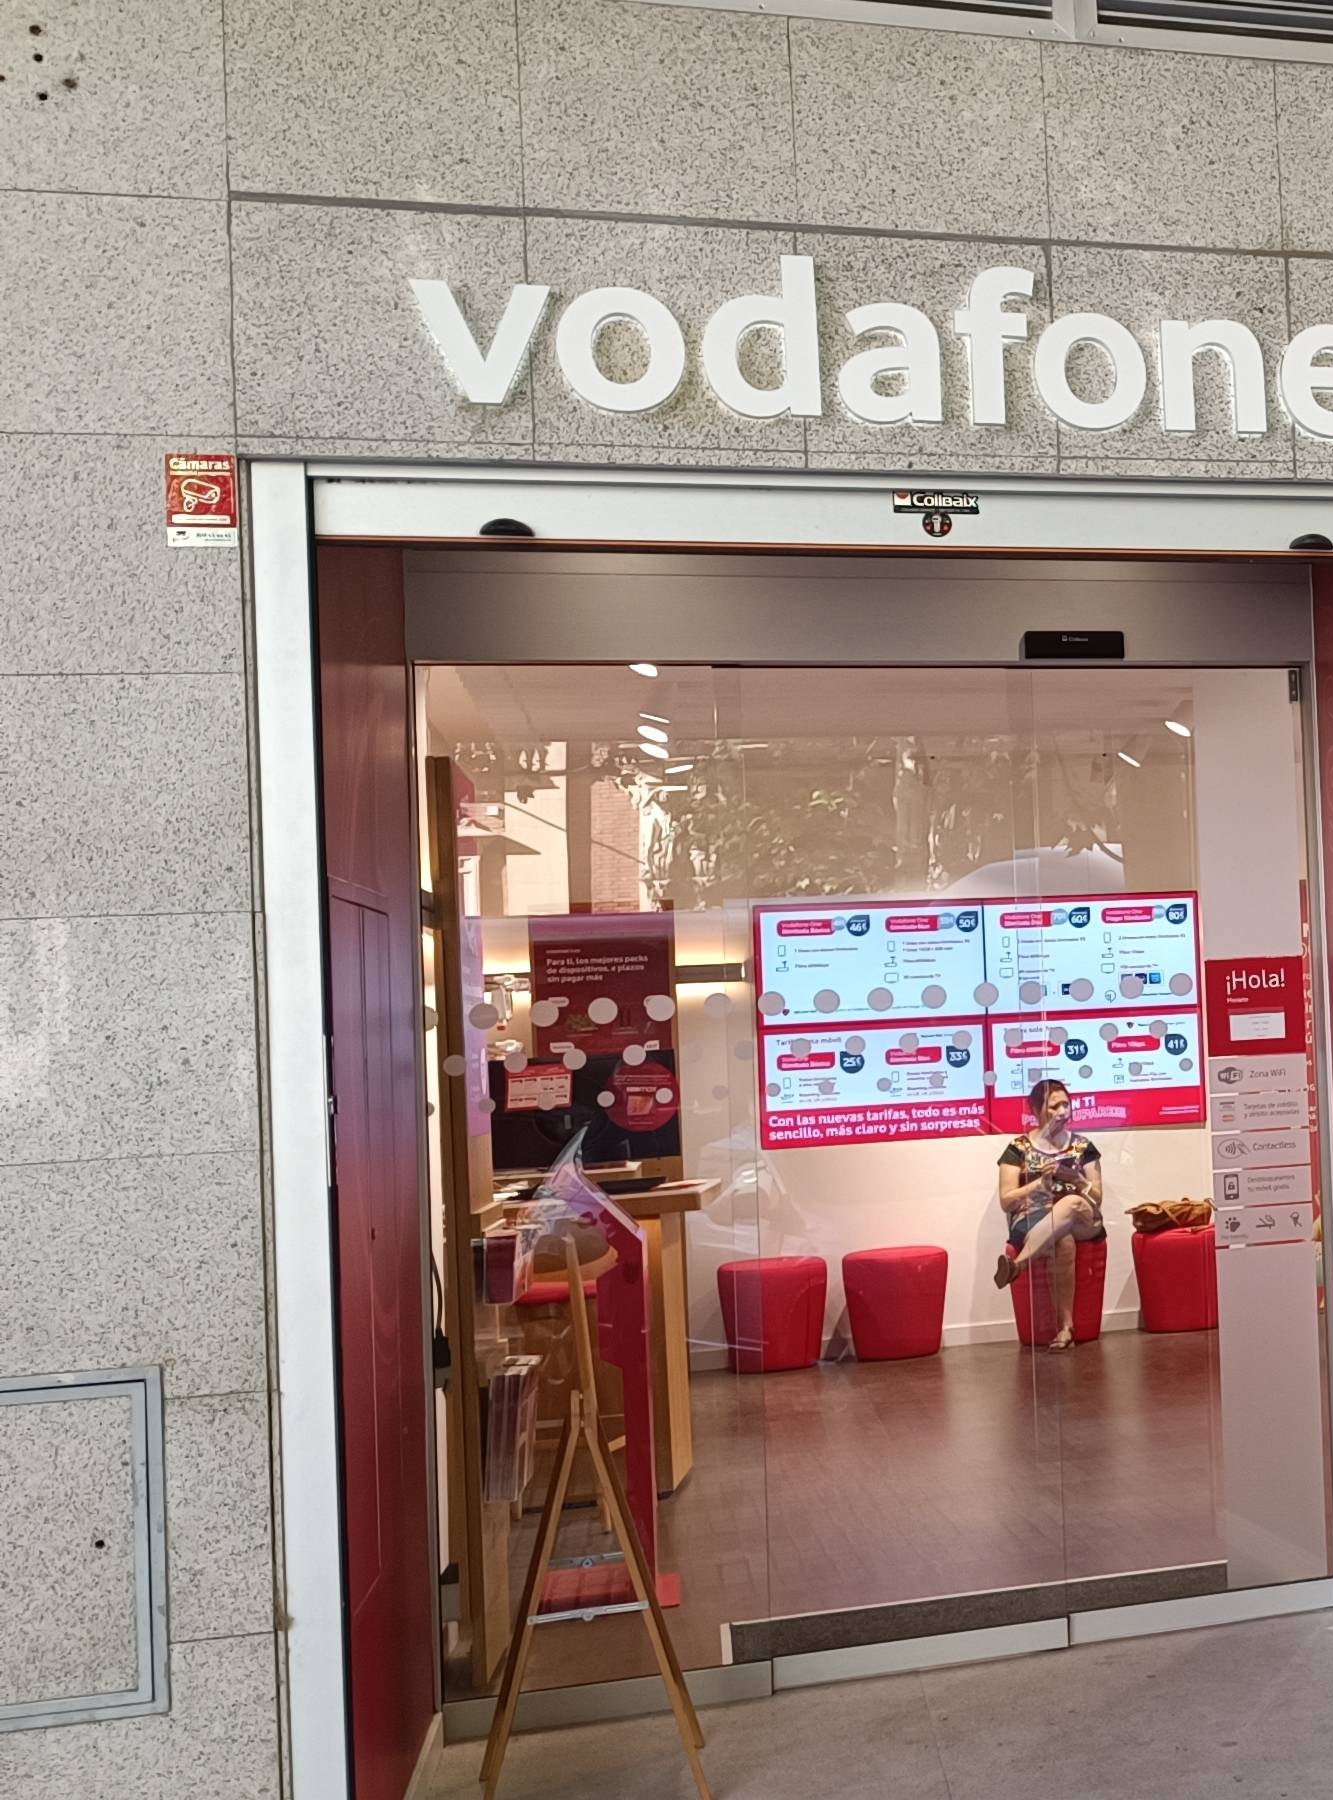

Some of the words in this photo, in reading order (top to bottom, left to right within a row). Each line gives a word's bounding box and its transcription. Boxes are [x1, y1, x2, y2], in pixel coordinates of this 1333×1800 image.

[169, 457, 231, 470] Cámaras
[1225, 967, 1286, 996] ¡Hola!
[1249, 1069, 1269, 1078] Zona
[769, 1115, 794, 1128] Con
[797, 1113, 816, 1126] las
[818, 1112, 864, 1125] nuevas
[866, 1109, 909, 1122] tarifas,
[911, 1107, 940, 1119] todo
[942, 1107, 956, 1117] es
[959, 1103, 985, 1116] más
[769, 1126, 823, 1141] sencillo,
[826, 1124, 852, 1137] más
[855, 1122, 885, 1135] claro
[900, 1119, 917, 1132] sin
[920, 1118, 981, 1133] sorpresas
[1252, 1141, 1296, 1151] Contactless
